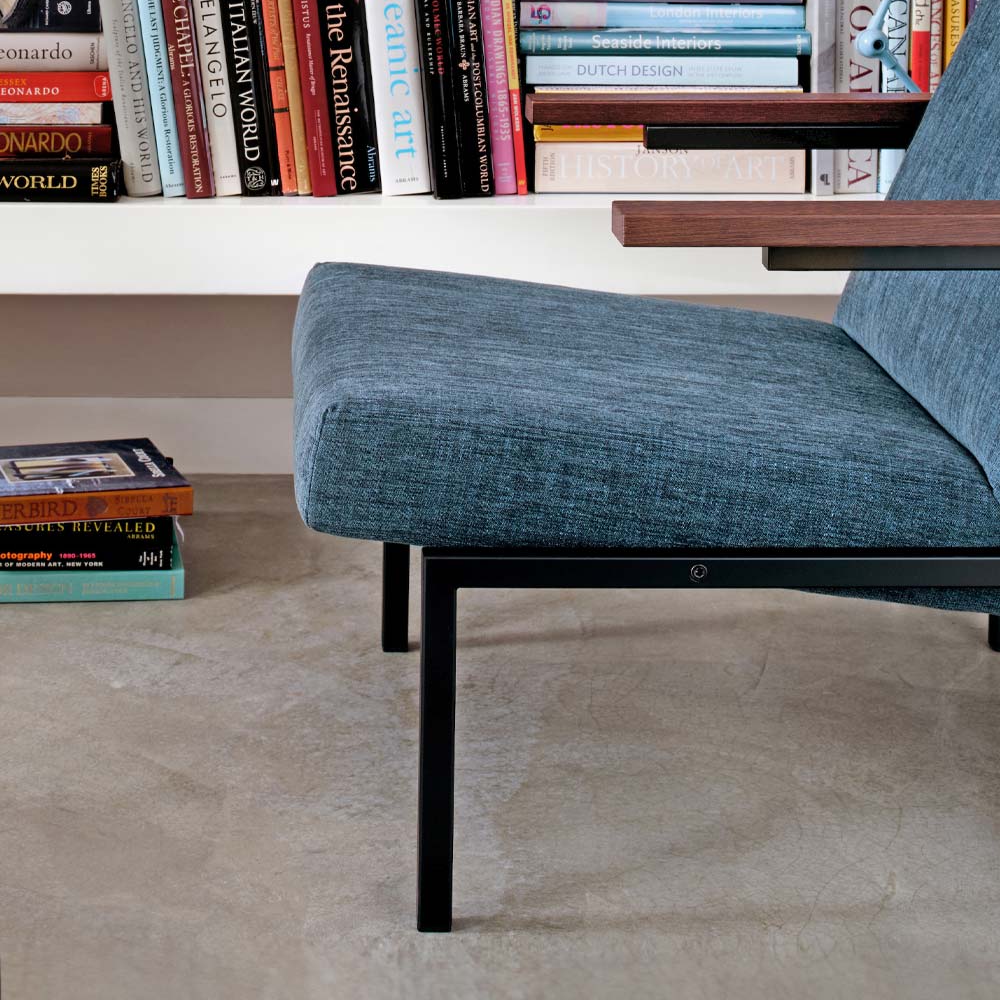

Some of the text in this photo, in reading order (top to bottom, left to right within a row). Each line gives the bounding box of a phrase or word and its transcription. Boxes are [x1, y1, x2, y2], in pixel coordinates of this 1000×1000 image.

[326, 3, 349, 42] the
[432, 0, 441, 36] OLMEC
[456, 1, 466, 58] BARBARA BRAUN
[469, 22, 478, 42] ART
[167, 44, 176, 70] Abrams
[174, 5, 192, 78] CHAPEL:
[493, 30, 506, 85] DRAWINGS
[592, 34, 722, 50] Seaside Interiors
[129, 61, 143, 94] AND
[228, 3, 250, 84] ITALIAN
[240, 92, 260, 162] WORLD
[577, 64, 627, 77] DUTCH
[631, 64, 683, 77] DESIGN
[133, 98, 146, 126] HIS
[149, 11, 176, 175] LAST JUDGMENT: Glorious Restoration
[184, 88, 195, 132] GLORIOUS
[472, 62, 488, 152] POST-COLUMBIAN
[497, 89, 510, 141] 1865-1935
[329, 45, 359, 190] Renaissance
[393, 110, 418, 159] art
[137, 130, 154, 183] WORLD
[188, 134, 204, 193] RESTORATION
[366, 144, 377, 182] Abrams
[478, 154, 490, 192] WORLD
[560, 152, 785, 180] HISTORY ART
